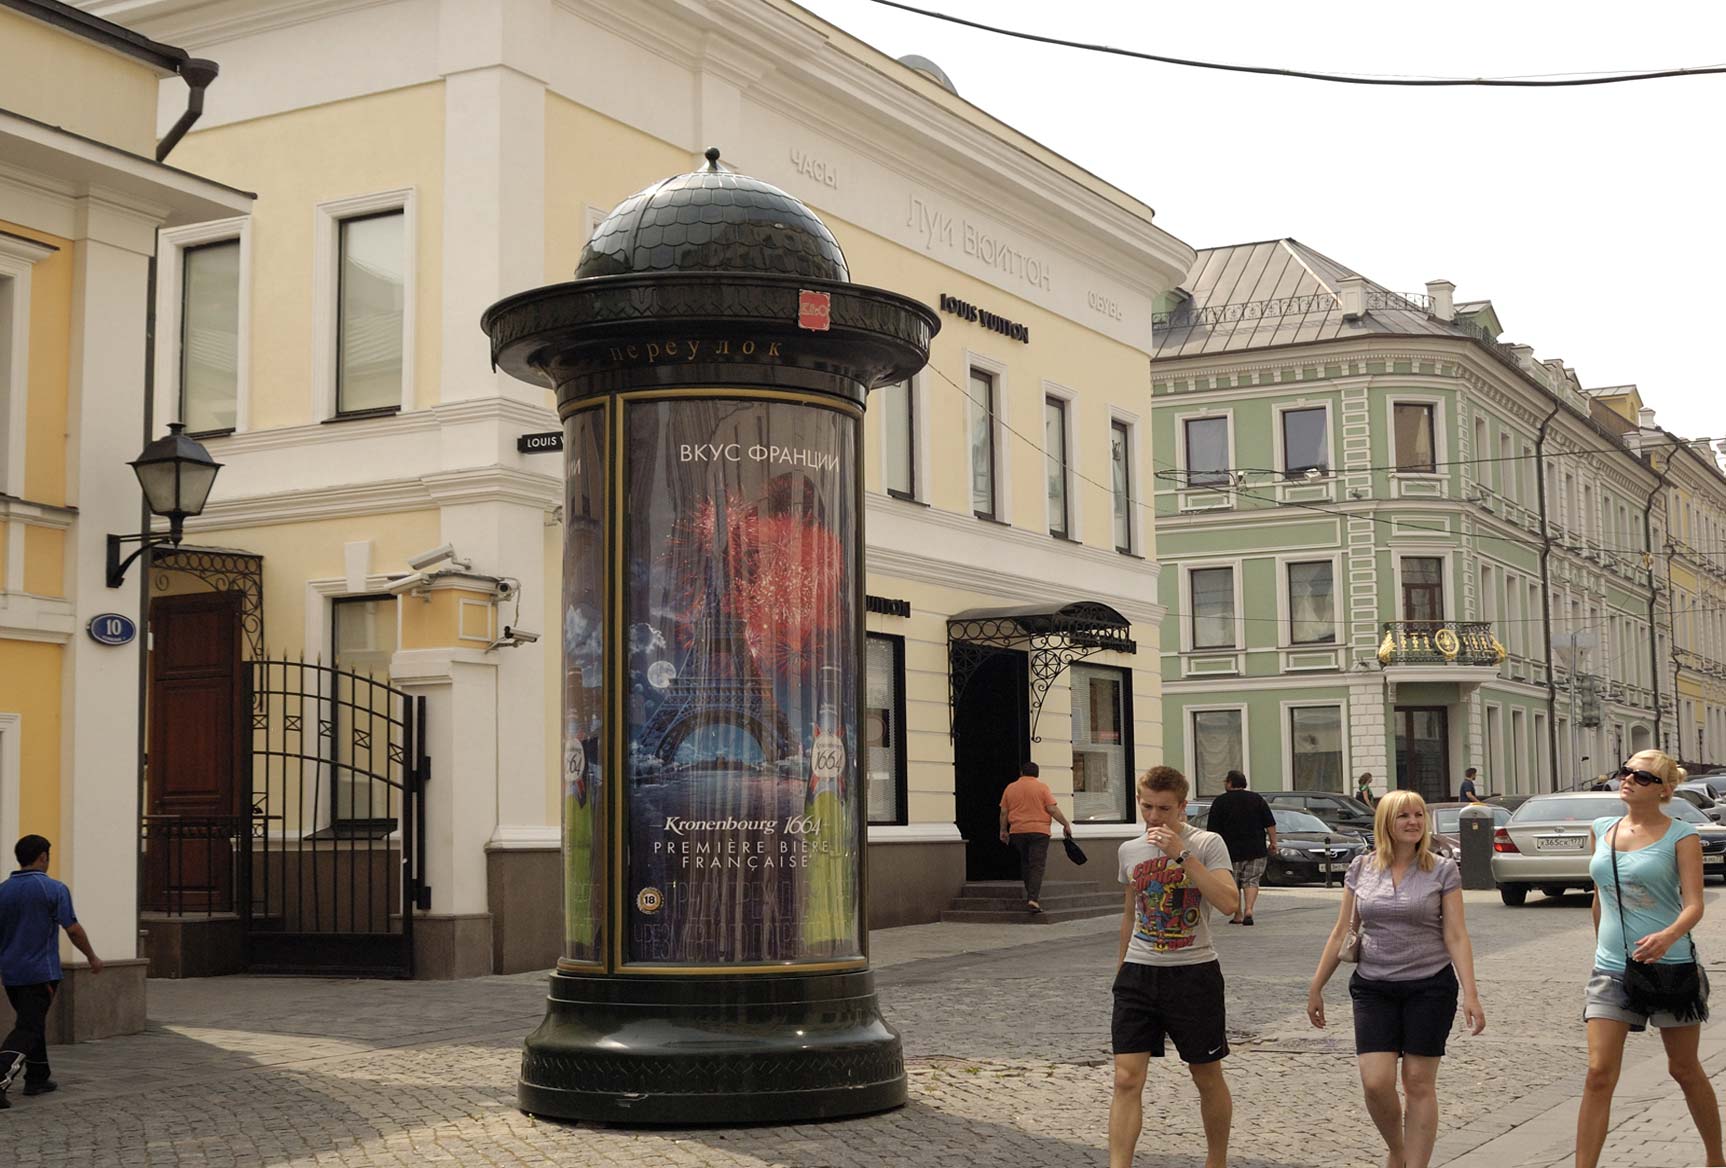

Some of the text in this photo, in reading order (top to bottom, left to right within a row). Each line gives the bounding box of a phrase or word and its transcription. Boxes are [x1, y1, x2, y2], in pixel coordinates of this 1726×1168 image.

[790, 149, 838, 190] ЧАСЫ
[905, 192, 1051, 292] ЛУИ ВЮИТТОН
[940, 293, 1029, 344] LOUIS VUITTON
[609, 339, 783, 363] переулок
[527, 436, 557, 448] LOUIS
[680, 443, 839, 473] ВКУС ФРАНЦИИ
[106, 619, 122, 635] 10
[814, 750, 843, 774] 1664
[664, 815, 822, 836] Kronenbourg 1664
[654, 838, 830, 854] PREMIÈRE BIÈRE
[682, 856, 809, 871] FRANÇAISE
[1133, 855, 1168, 879] CULT
[1131, 867, 1184, 894] OMICS
[644, 895, 655, 904] 18
